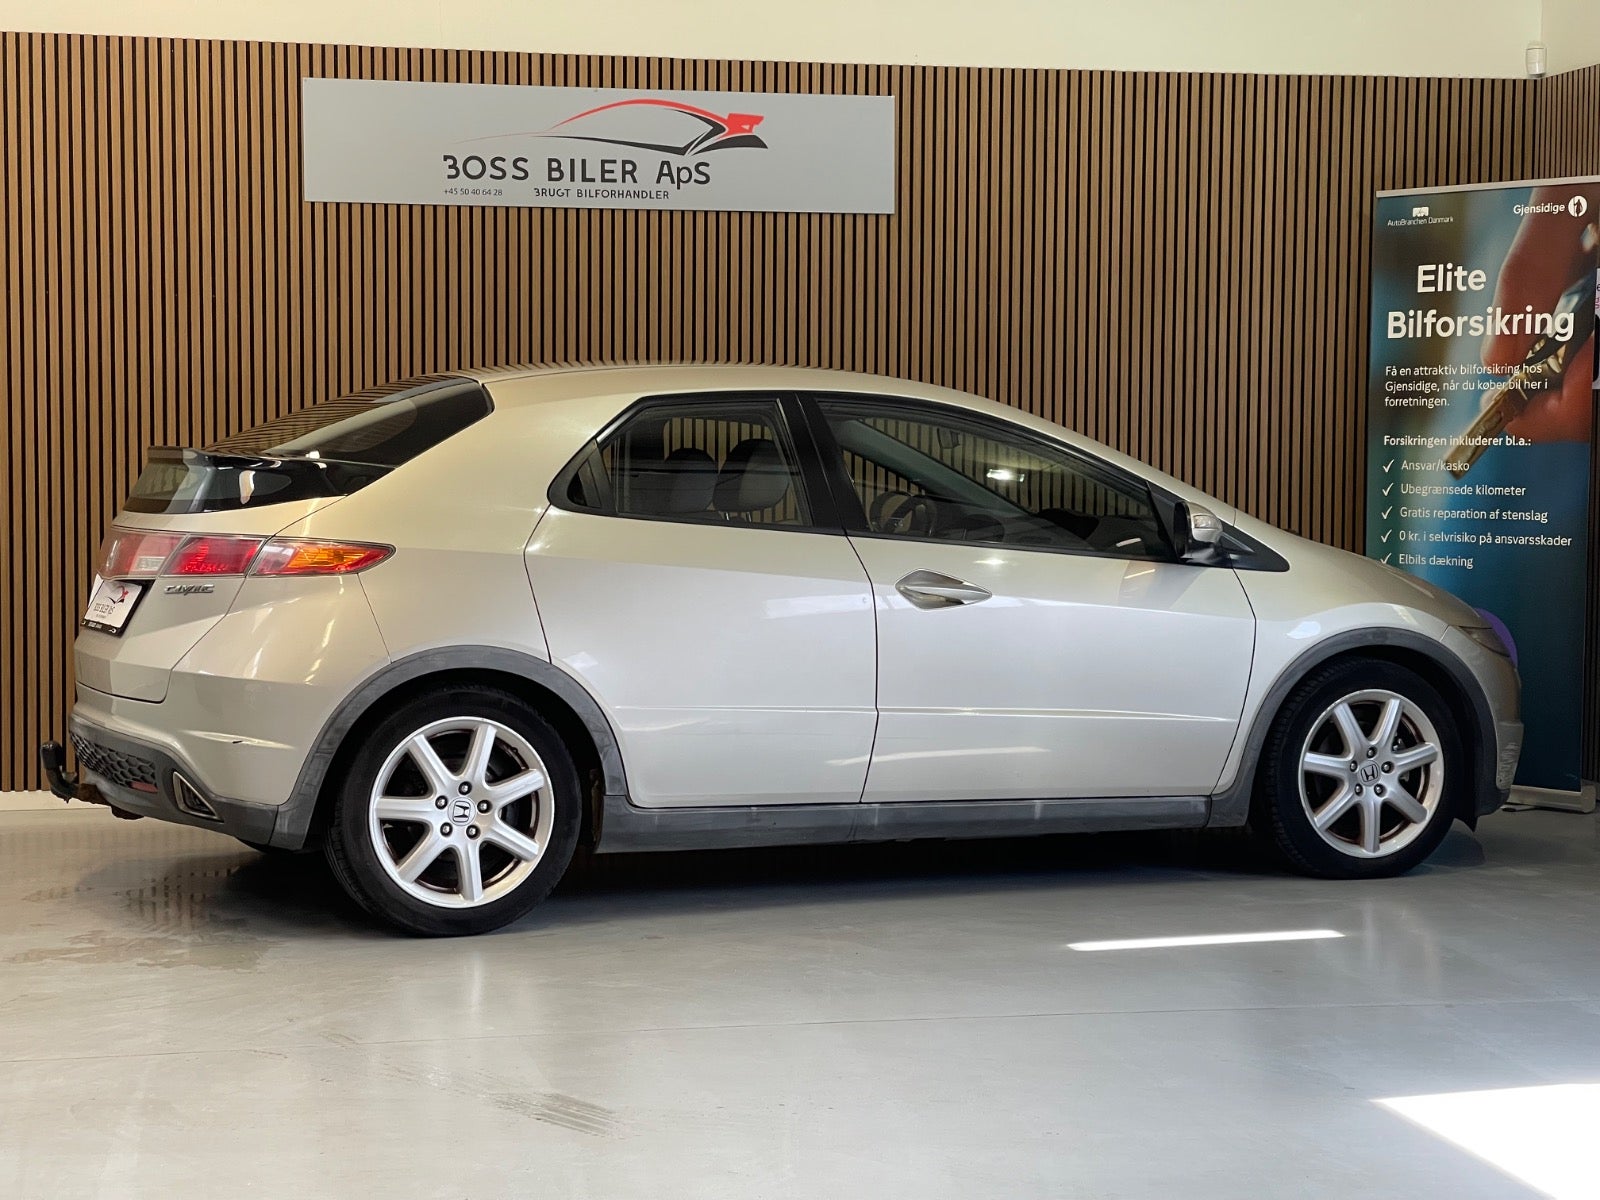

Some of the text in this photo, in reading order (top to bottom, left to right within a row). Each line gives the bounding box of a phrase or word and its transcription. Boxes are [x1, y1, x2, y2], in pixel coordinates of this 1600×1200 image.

[547, 157, 638, 184] BILER
[655, 160, 711, 190] ApS
[444, 187, 503, 196] +45 50 40 64 28
[576, 188, 669, 200] BILFORHANDLER
[1513, 203, 1565, 217] Gjensidige
[1428, 216, 1454, 224] Danmark
[1416, 263, 1486, 293] Elite
[1387, 305, 1574, 342] Bilforsikring
[1385, 363, 1542, 377] Få en attraktiv bilforsikring hos
[1385, 378, 1548, 394] Gjensidige, når du køber bil her i
[1385, 396, 1450, 408] forretningen.
[1384, 436, 1532, 447] Forsikringen inkluderer bl.a.:
[1401, 460, 1470, 472] Ansvar/kasko
[1401, 484, 1526, 497] Ubegrænsede kilometer
[1400, 506, 1548, 523] Gratis reparation af stenslag
[1399, 530, 1406, 541] 0
[1408, 530, 1420, 542] kr.
[1429, 532, 1476, 543] selvrisiko
[1479, 532, 1492, 546] på
[1494, 534, 1572, 546] ansvarsskader
[1399, 554, 1474, 569] Elbils dækning
